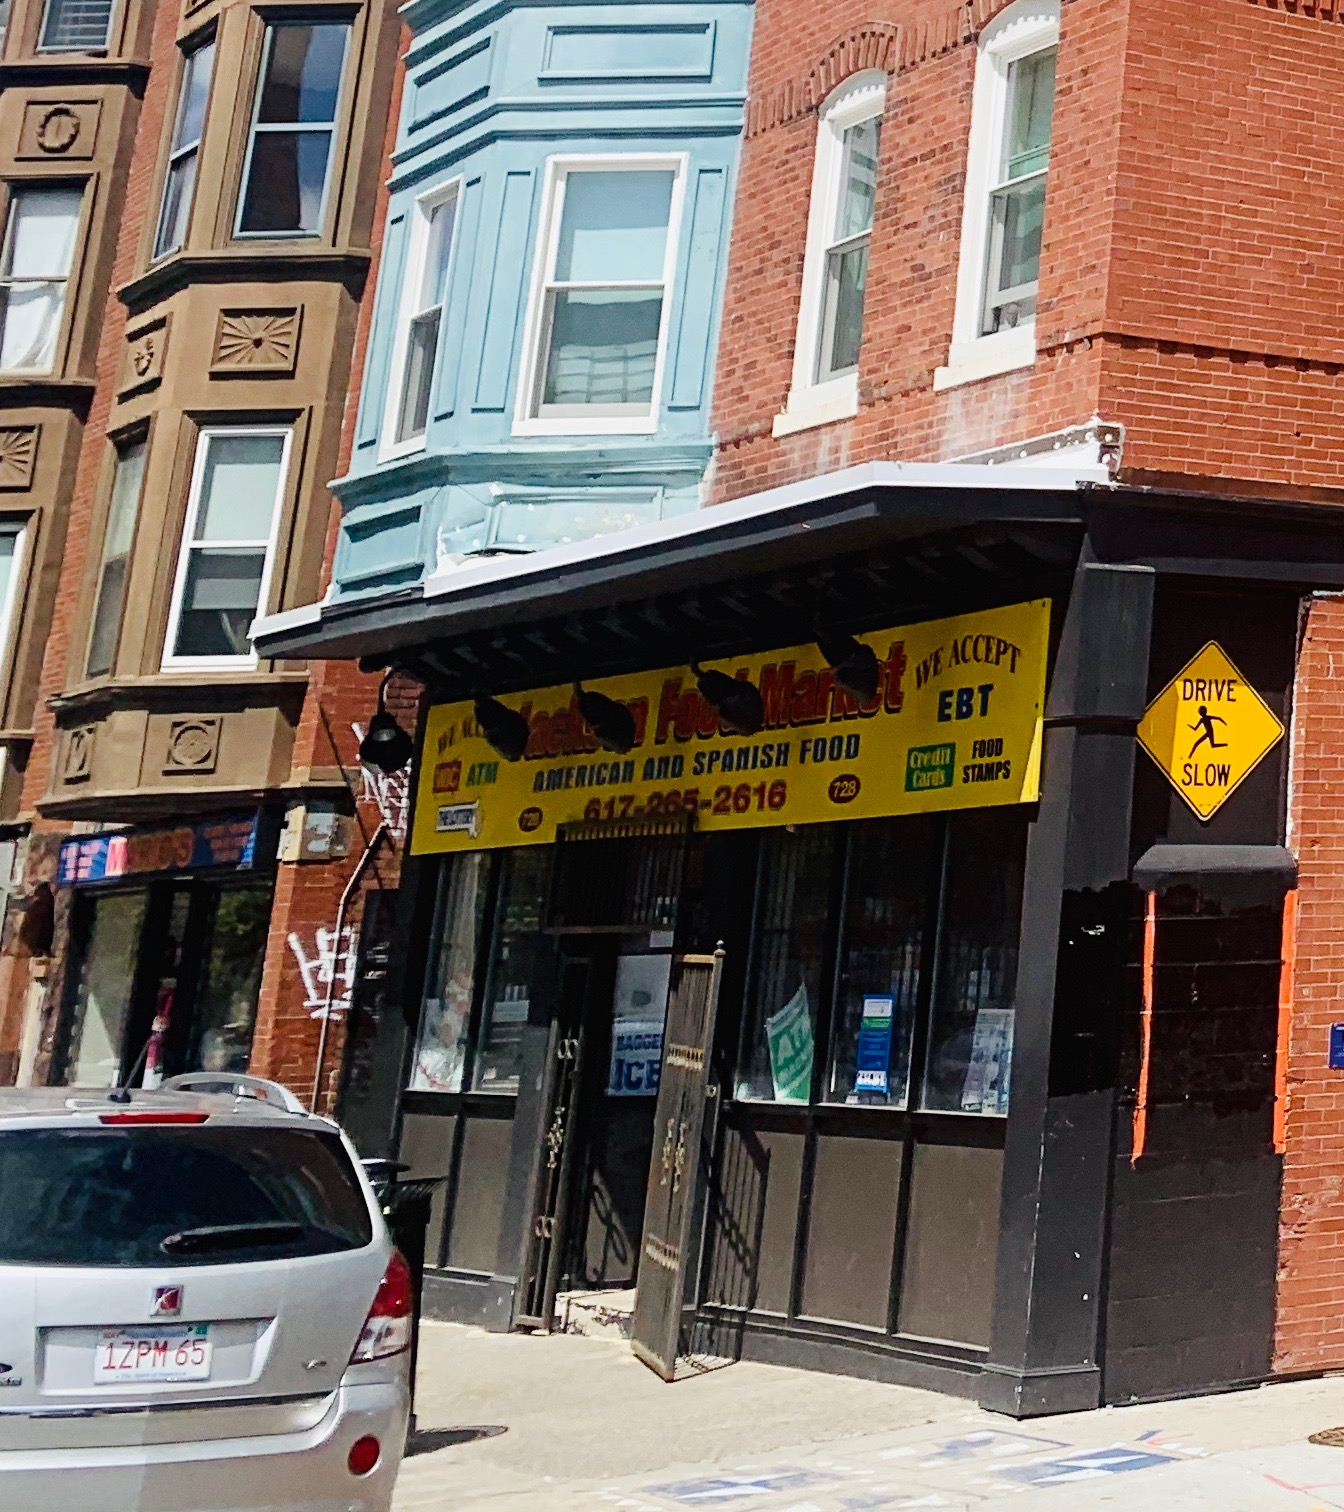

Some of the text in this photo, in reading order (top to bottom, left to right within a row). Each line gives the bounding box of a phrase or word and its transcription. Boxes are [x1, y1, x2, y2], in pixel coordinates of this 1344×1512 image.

[916, 634, 1021, 688] WE ACCEPT
[937, 683, 994, 722] EBT
[1182, 678, 1237, 702] DRIVE
[655, 668, 753, 745] Foo
[909, 746, 951, 769] Credit
[972, 738, 1003, 760] FOOD
[466, 761, 499, 786] ATM
[533, 733, 860, 793] AMERICAN AND SPANISH FOOD
[962, 760, 1011, 784] STAMPS
[1182, 763, 1231, 787] SLOW
[584, 779, 787, 821] 617-265-2616
[833, 778, 857, 798] 728
[616, 1033, 660, 1051] BAGGE
[613, 1058, 661, 1090] ICE
[103, 1337, 207, 1370] 1ZPM 65
